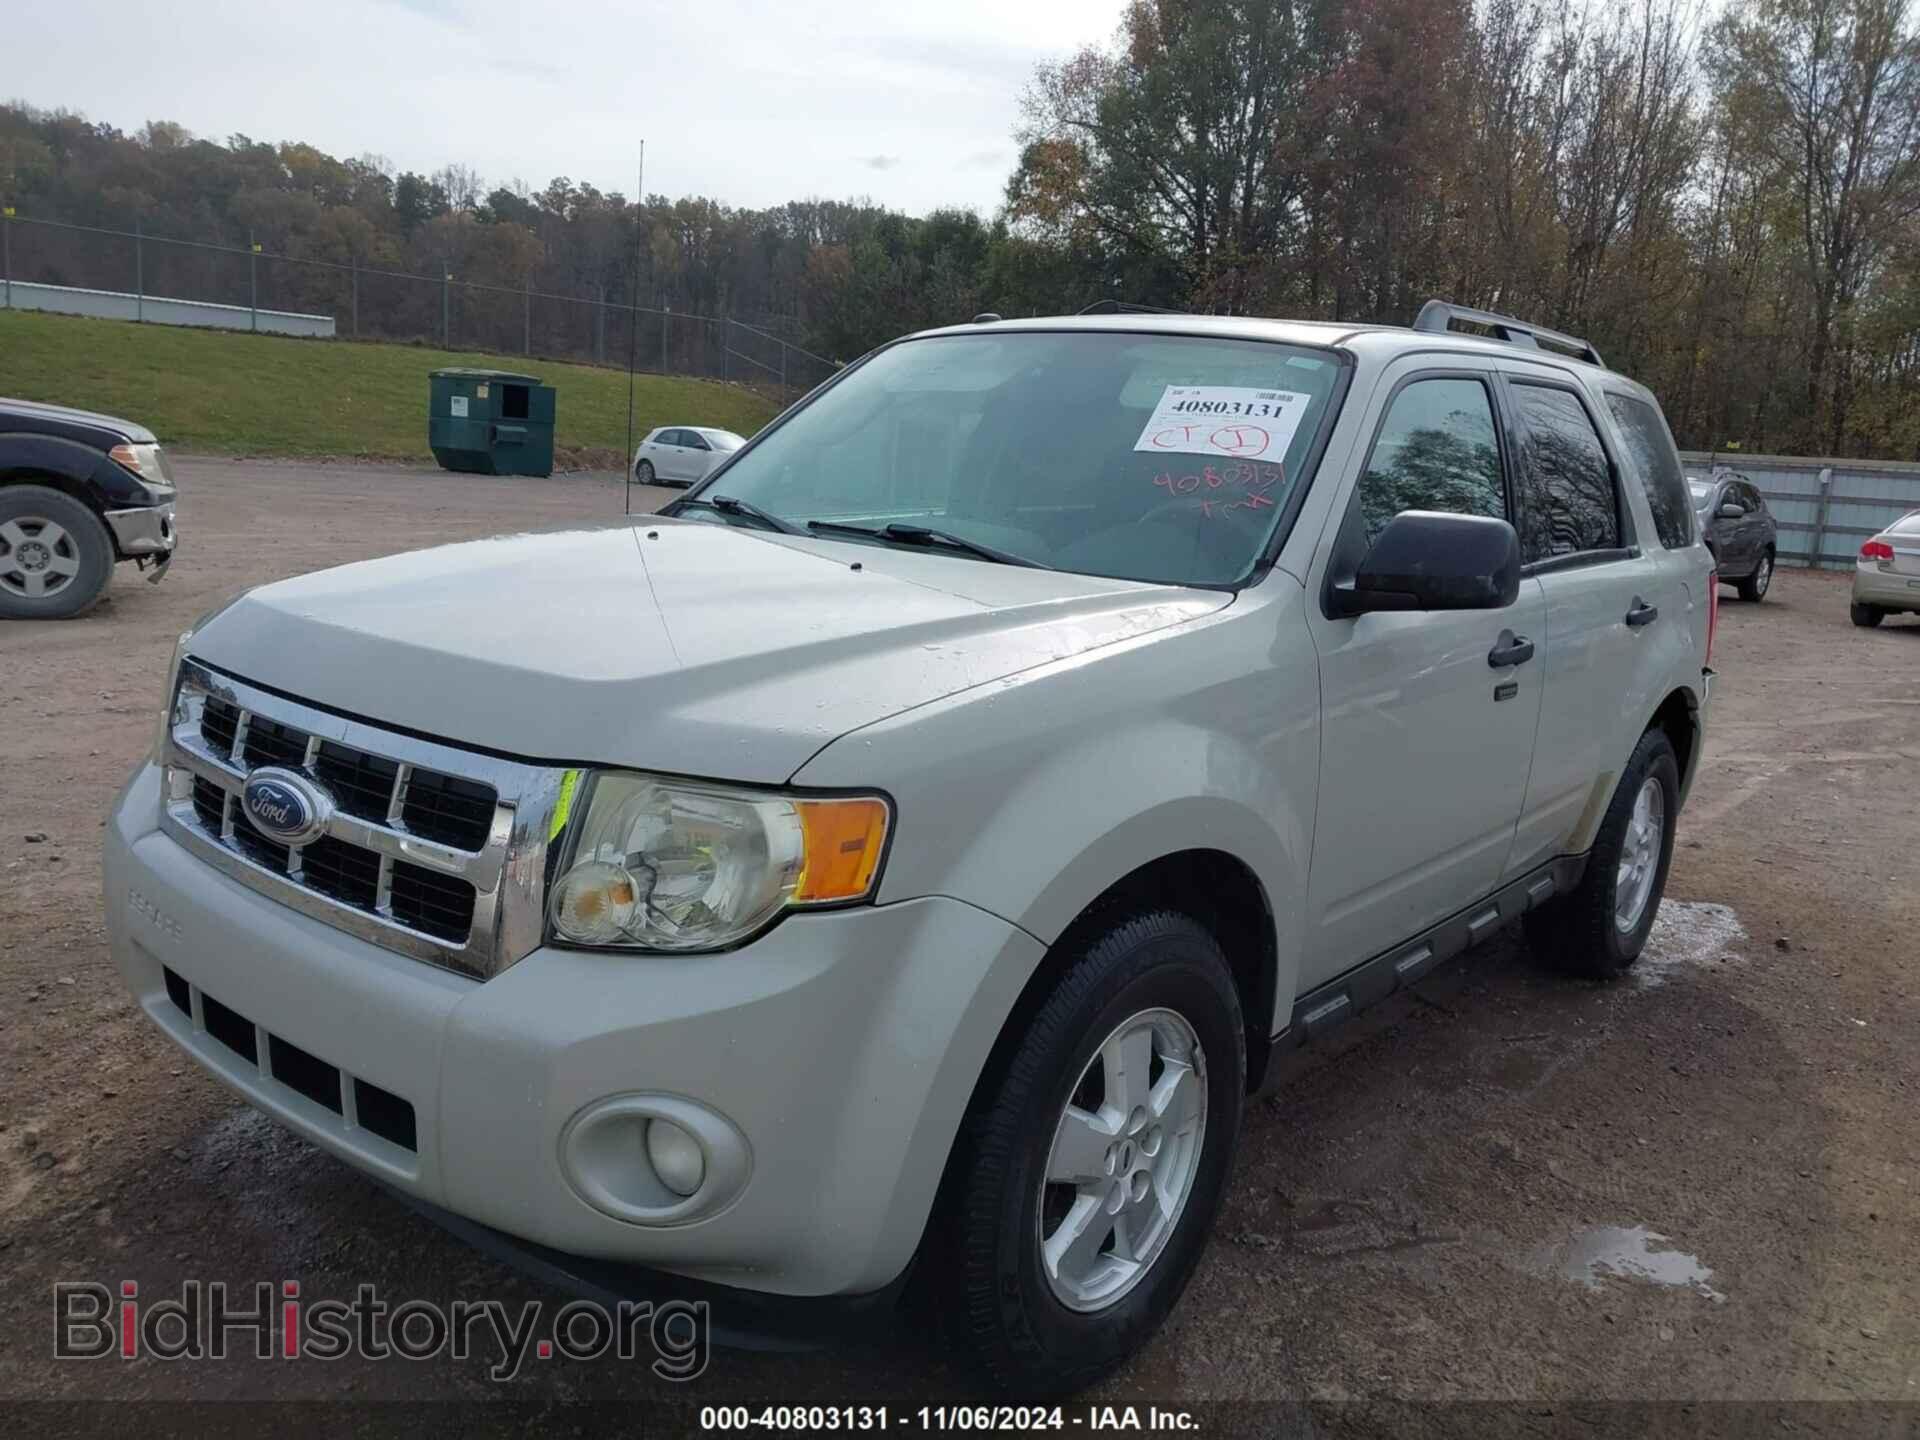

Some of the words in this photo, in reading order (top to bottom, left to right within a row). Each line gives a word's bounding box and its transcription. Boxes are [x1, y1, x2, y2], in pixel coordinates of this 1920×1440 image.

[1171, 399, 1283, 418] 40803131
[1152, 463, 1286, 497] 40803131
[251, 786, 291, 824] Ford
